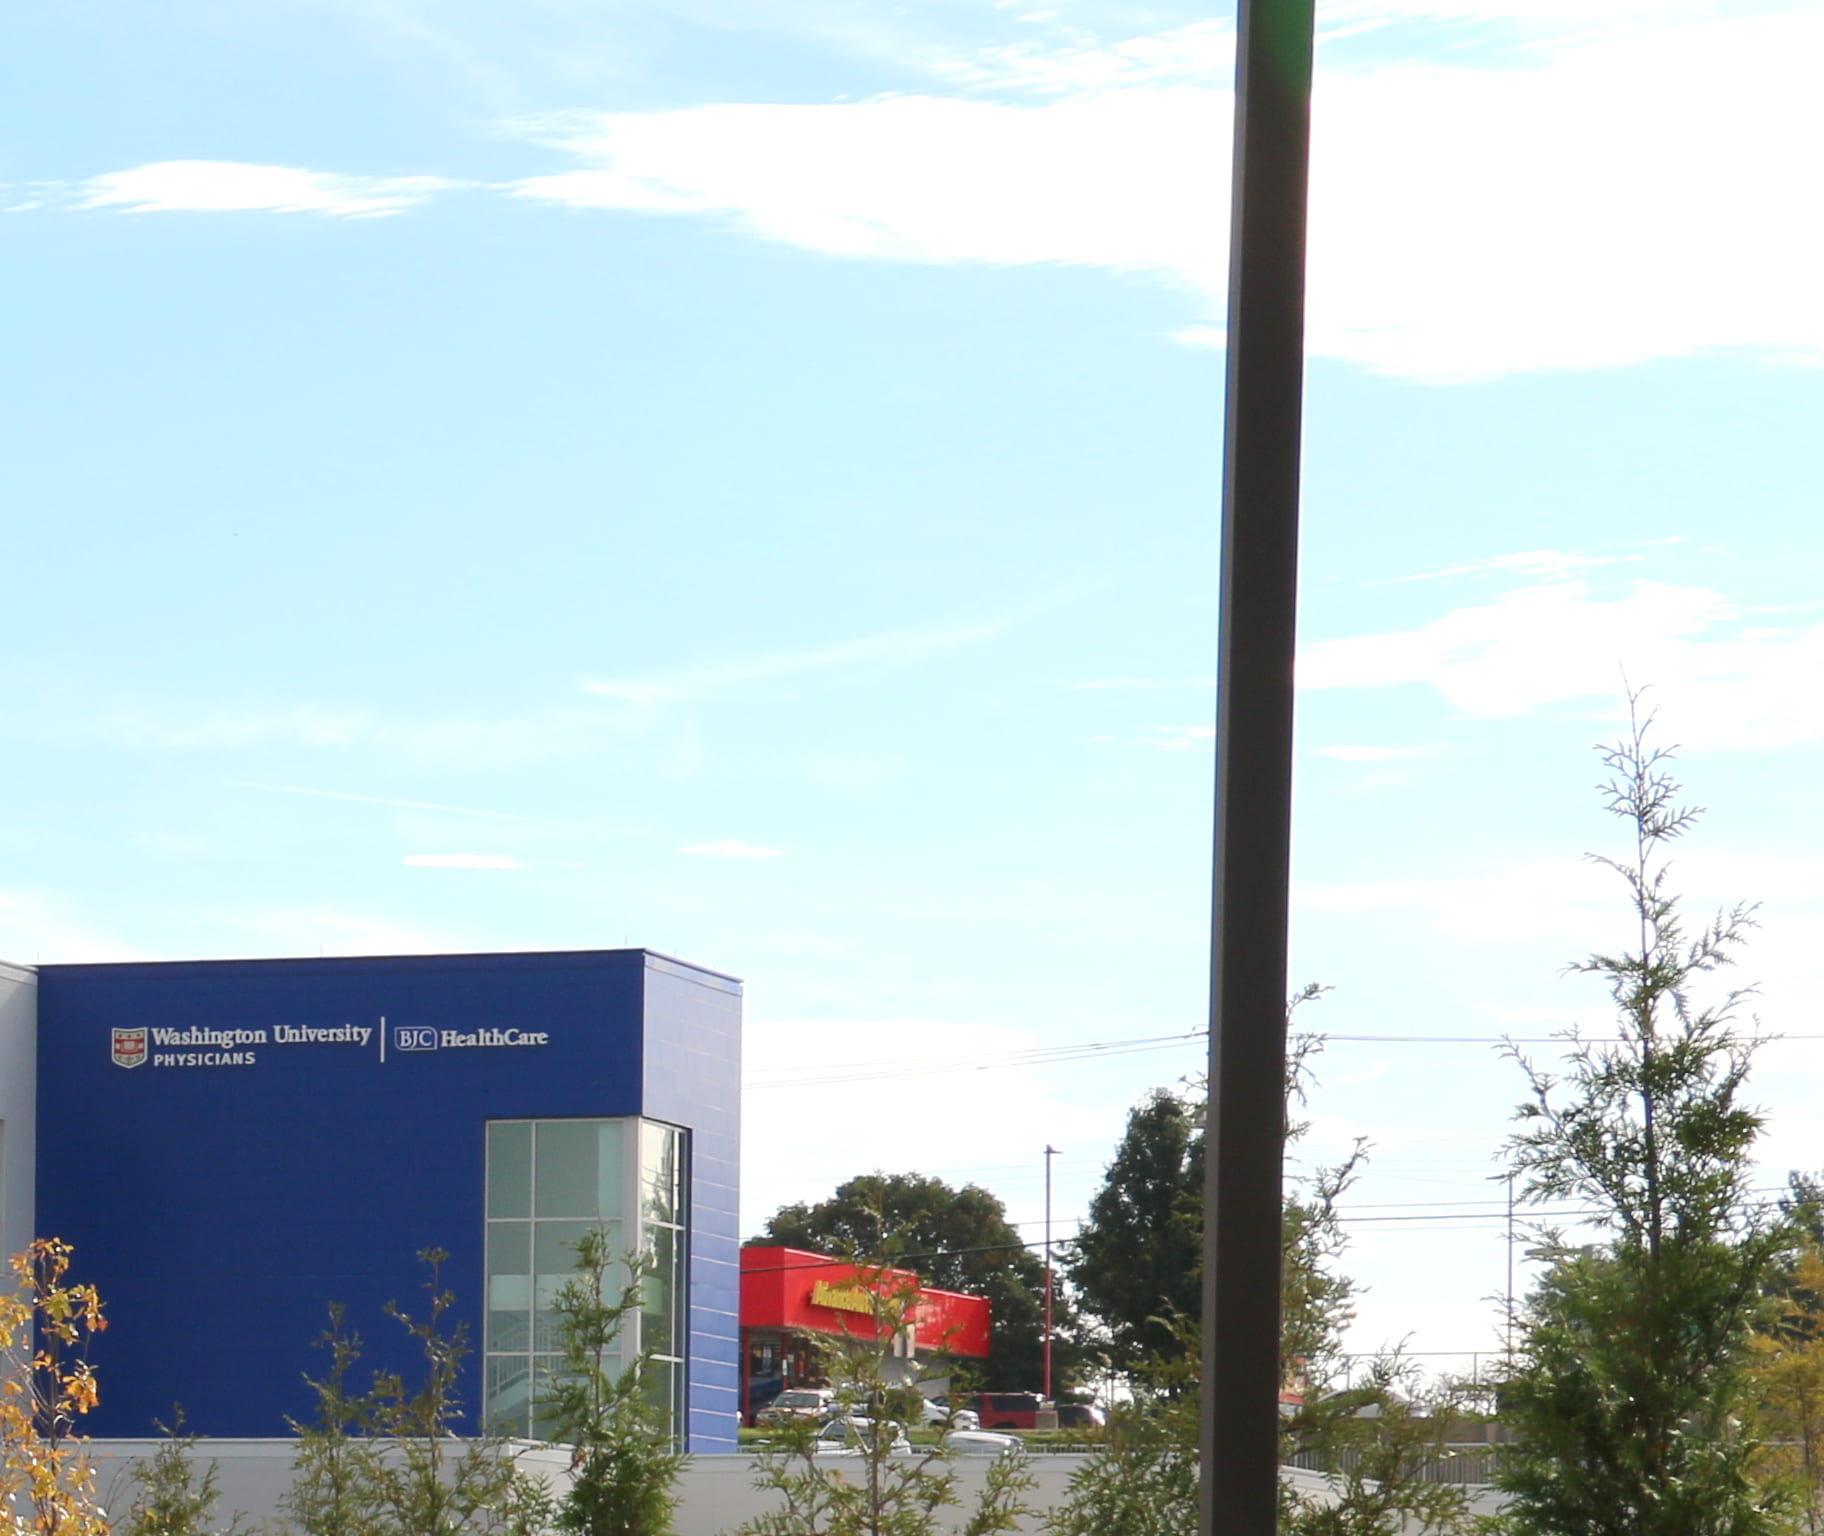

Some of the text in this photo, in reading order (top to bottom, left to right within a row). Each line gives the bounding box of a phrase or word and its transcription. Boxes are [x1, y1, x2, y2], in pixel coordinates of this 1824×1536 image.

[151, 1024, 372, 1049] Washington University
[399, 1029, 433, 1048] BJC
[441, 1029, 549, 1047] HealthCare
[153, 1052, 256, 1067] PHYSICIANS
